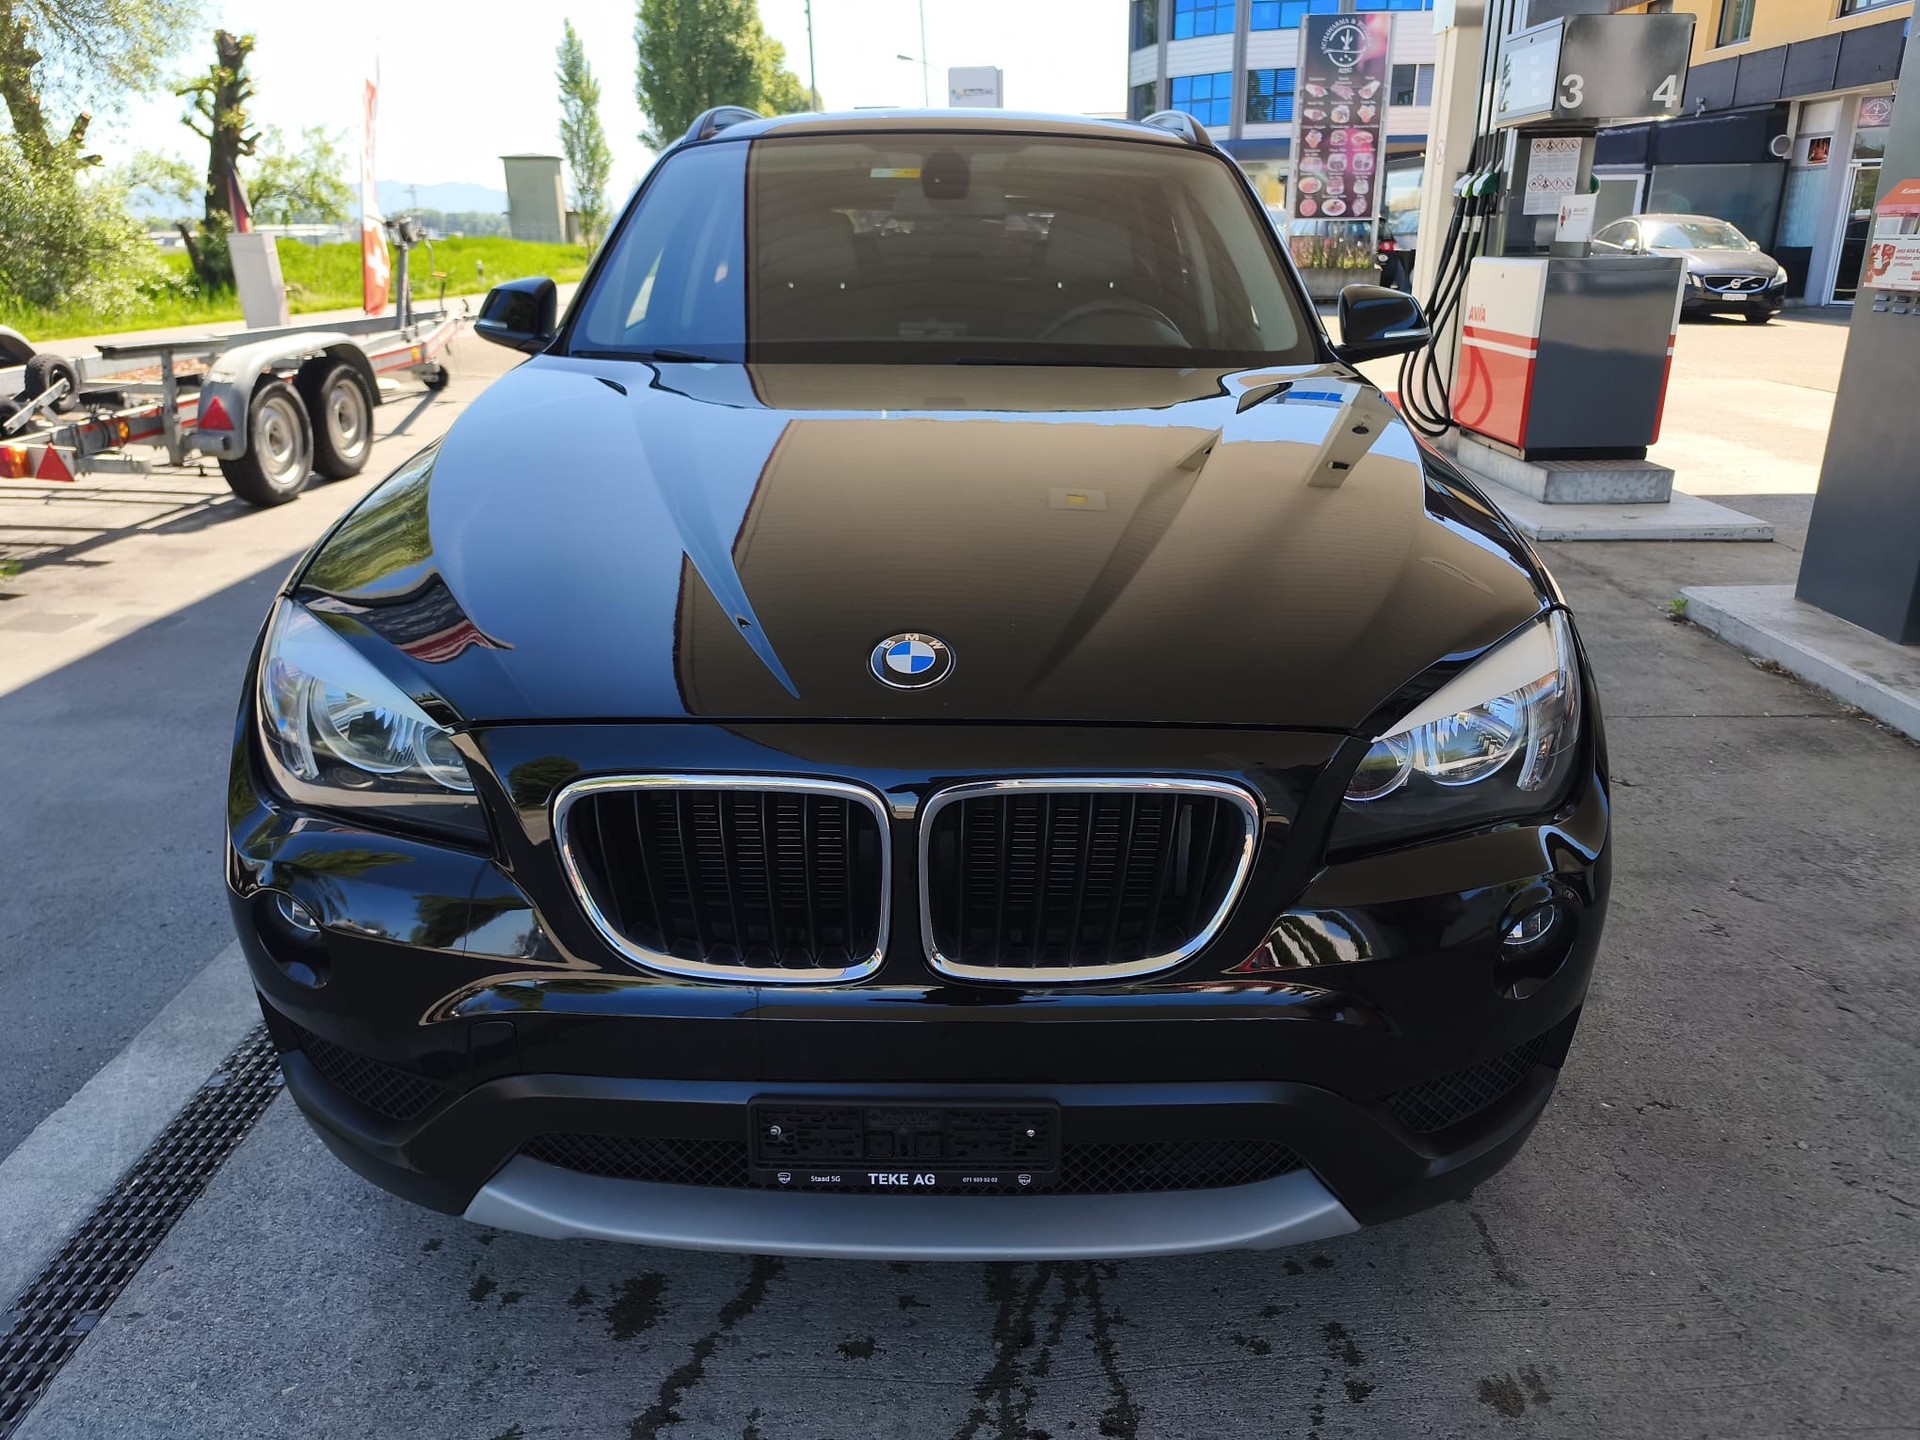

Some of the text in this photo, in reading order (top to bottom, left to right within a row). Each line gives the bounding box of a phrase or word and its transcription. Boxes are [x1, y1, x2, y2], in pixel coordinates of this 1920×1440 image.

[1560, 74, 1584, 108] 3
[1652, 75, 1678, 107] 4
[880, 633, 944, 649] BMW
[868, 1173, 936, 1185] TEKE AG
